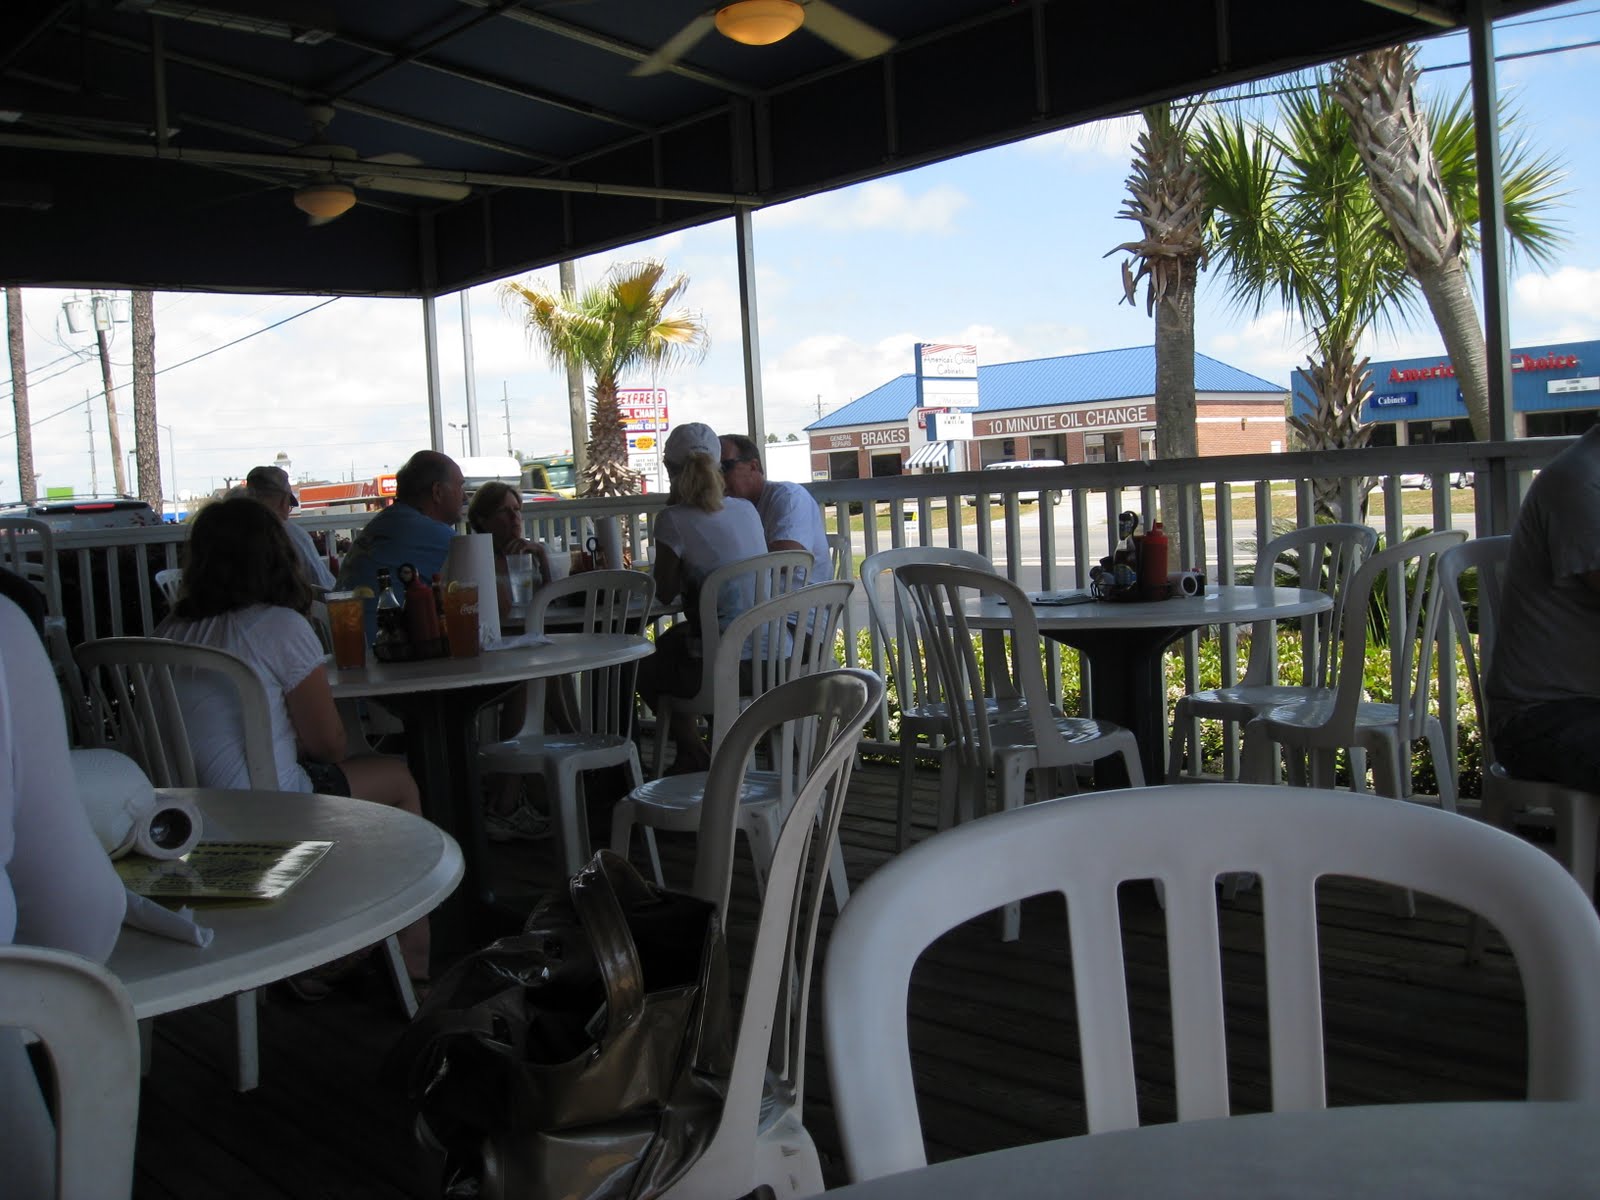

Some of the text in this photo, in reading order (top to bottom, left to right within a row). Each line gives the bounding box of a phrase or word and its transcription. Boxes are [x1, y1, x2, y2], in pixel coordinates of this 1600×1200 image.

[954, 352, 976, 365] Choice
[937, 364, 964, 375] Cabinets
[1388, 362, 1455, 384] Americ
[1377, 395, 1407, 405] Cabinets
[634, 408, 665, 418] CHANE
[988, 406, 1148, 434] 10 MINUTE OIL CHANGE
[861, 429, 906, 445] BRAKES
[831, 440, 852, 448] REPAIRS
